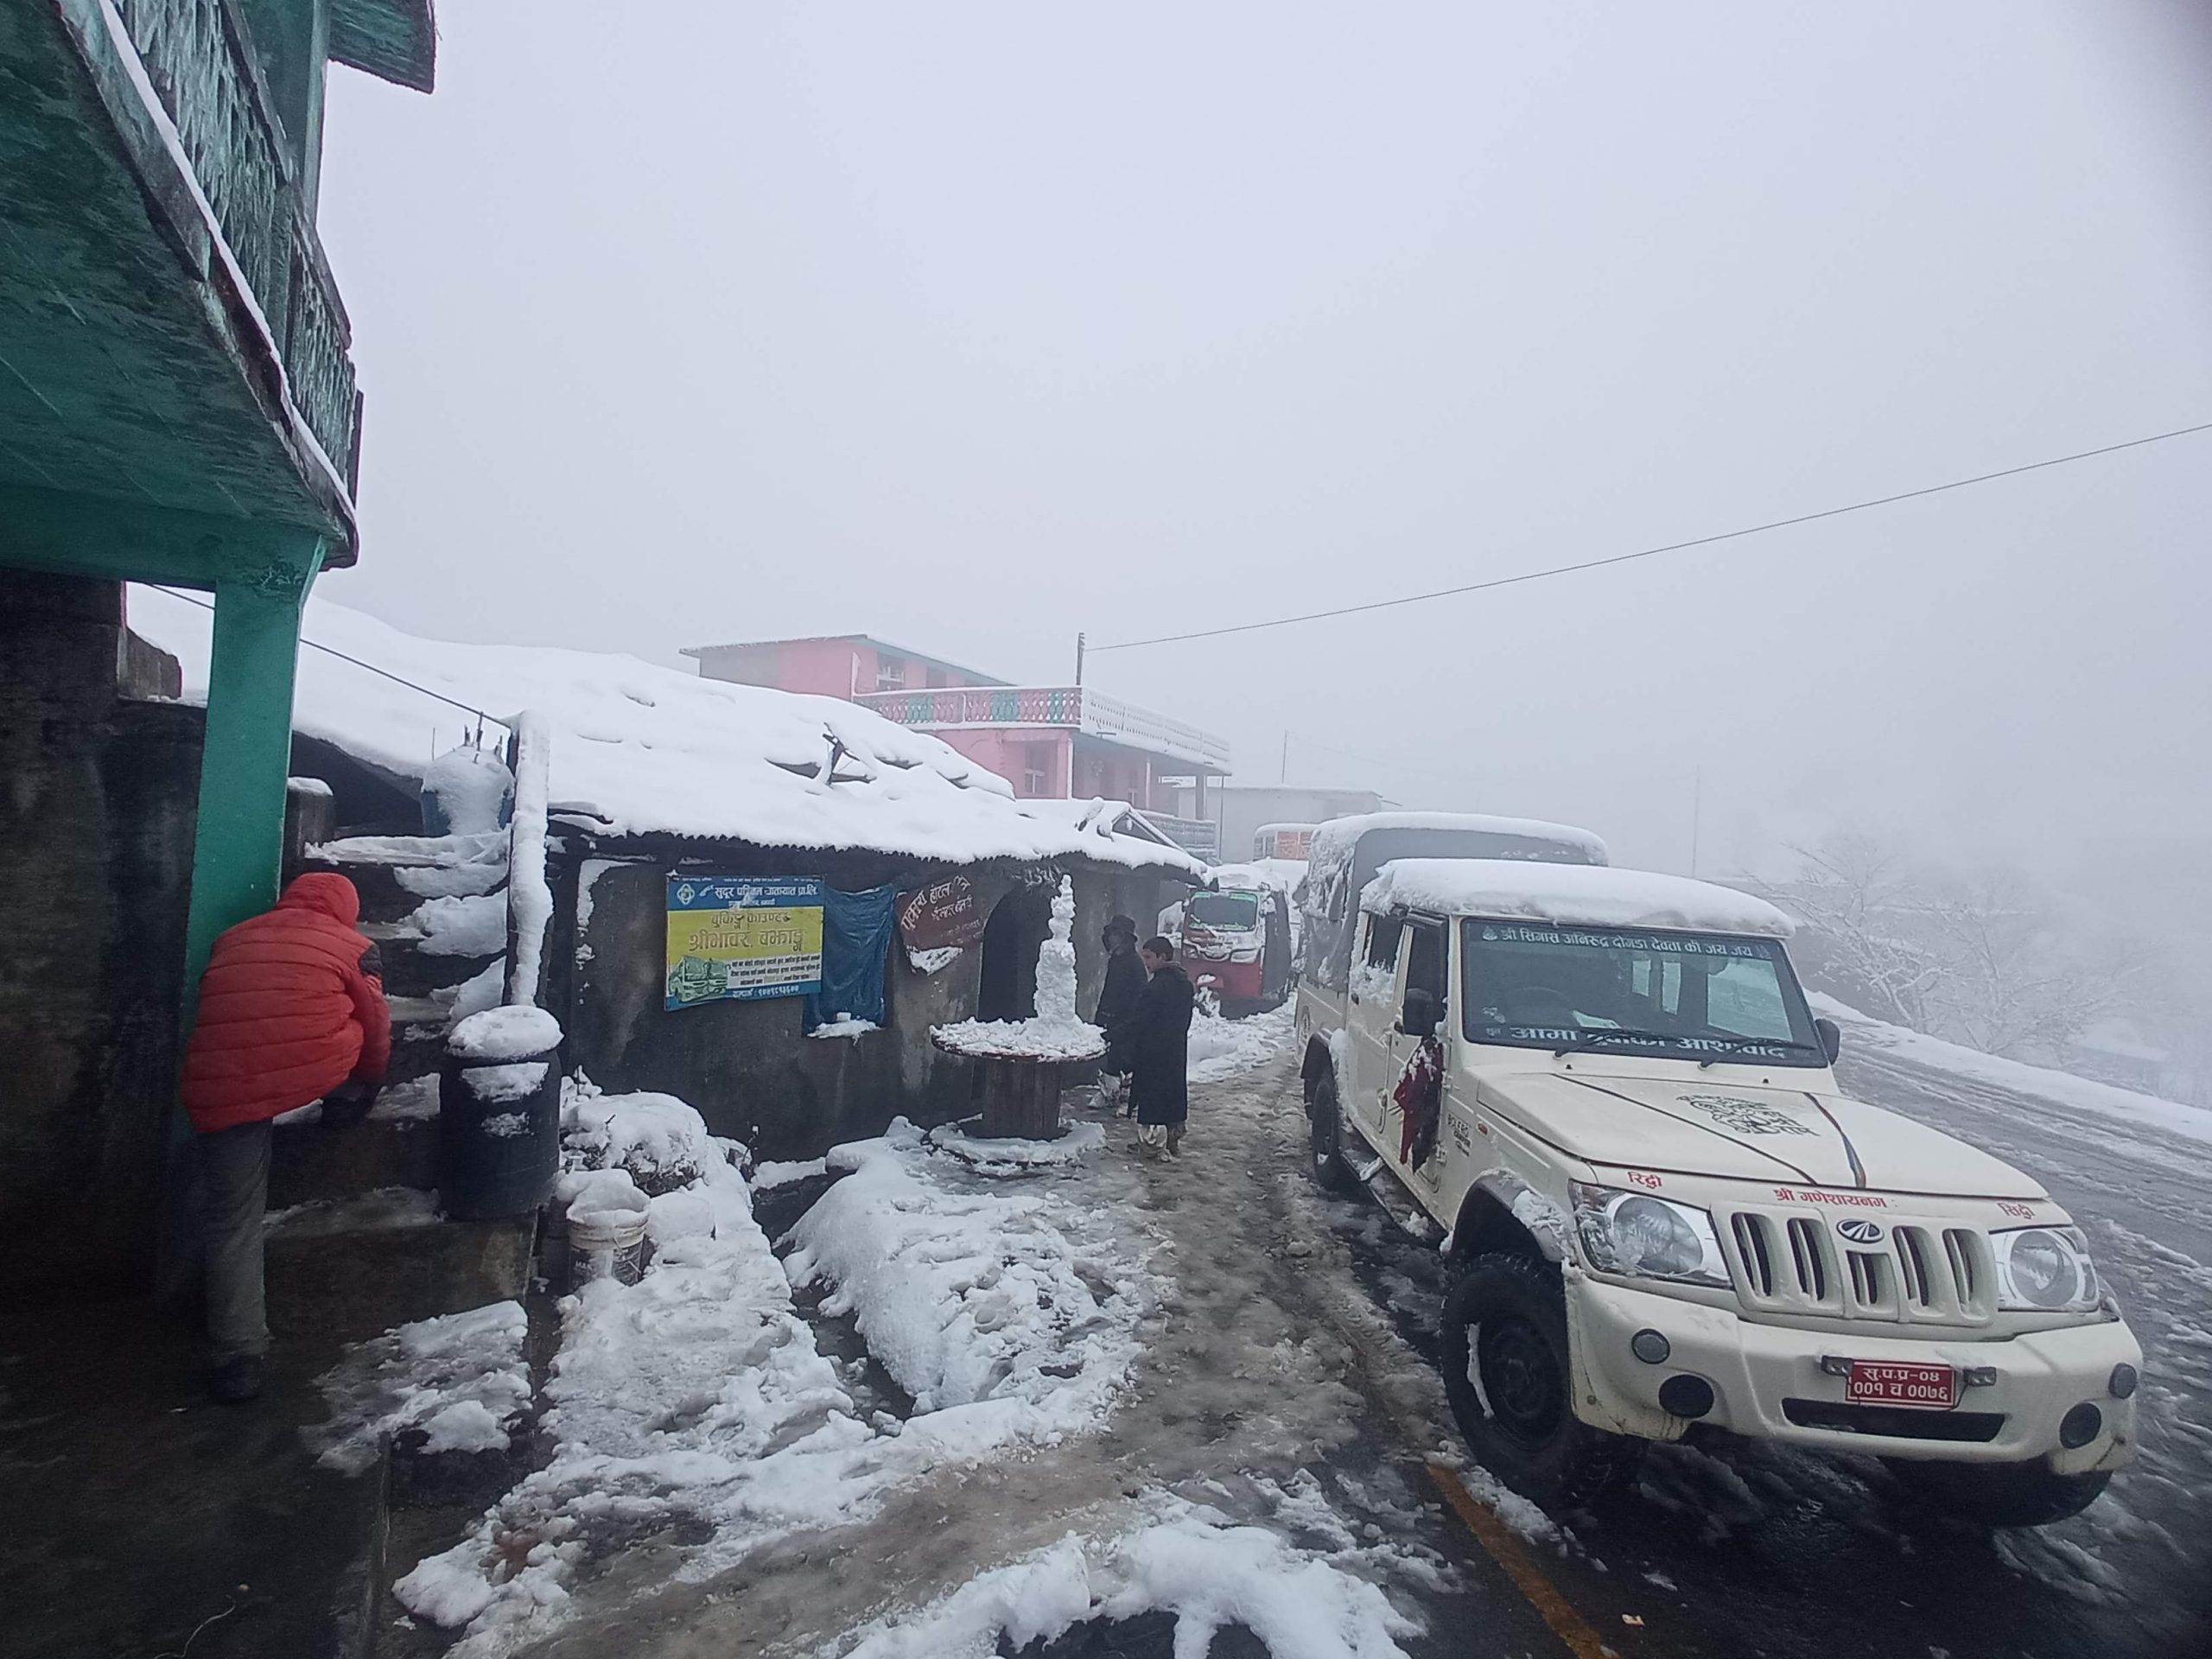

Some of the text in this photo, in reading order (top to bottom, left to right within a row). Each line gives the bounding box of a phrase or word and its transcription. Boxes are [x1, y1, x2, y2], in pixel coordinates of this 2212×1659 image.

[715, 887, 735, 899] सुदूर
[1501, 927, 1516, 941] श्री
[1650, 936, 1682, 952] देवता
[1685, 939, 1701, 953] की
[1706, 944, 1726, 956] जय
[1732, 945, 1753, 957] जय
[1773, 1187, 1796, 1201] श्री
[1853, 1382, 1948, 1401] ००१ च ००७६
